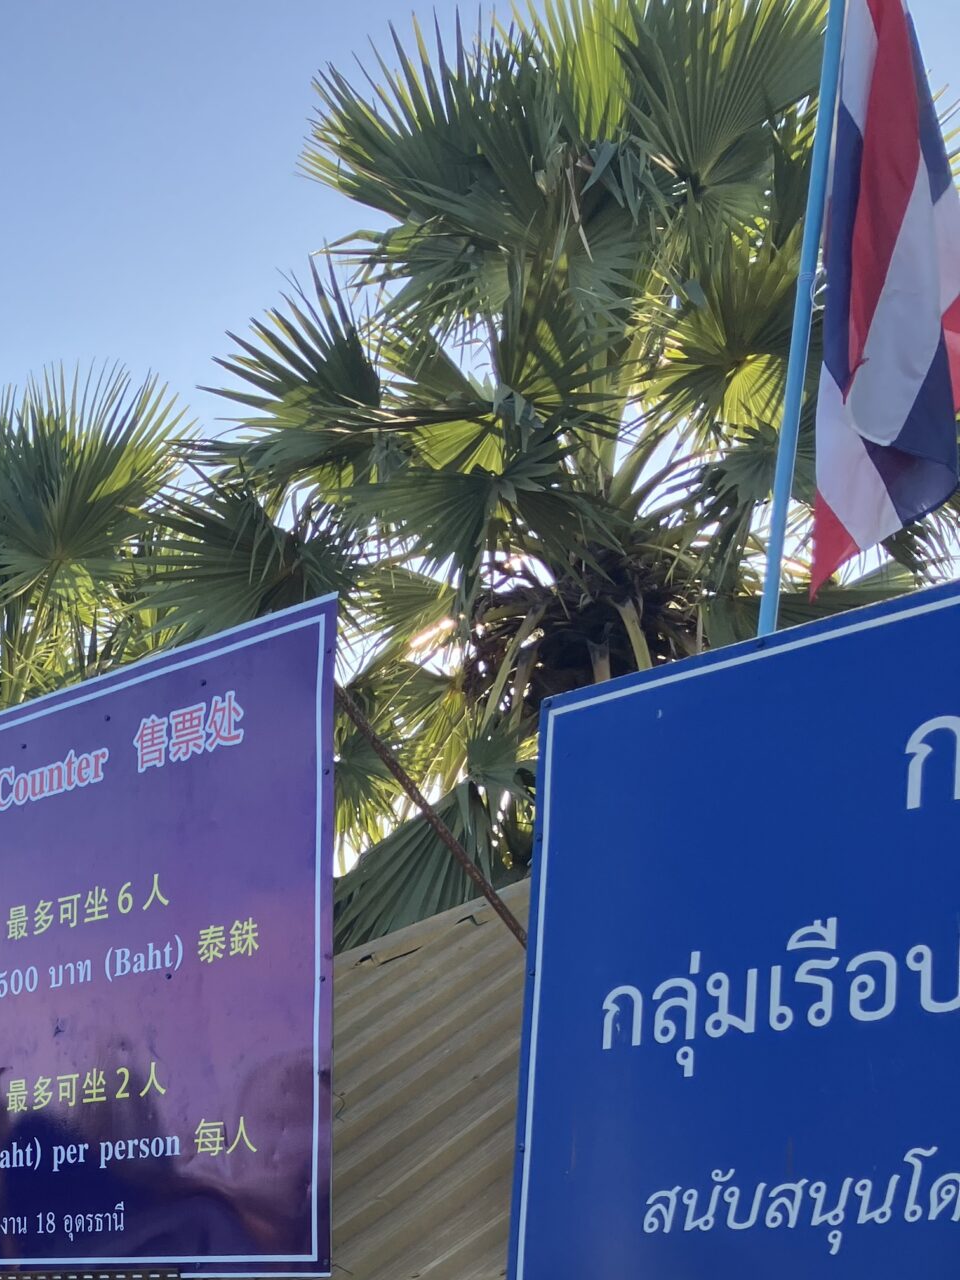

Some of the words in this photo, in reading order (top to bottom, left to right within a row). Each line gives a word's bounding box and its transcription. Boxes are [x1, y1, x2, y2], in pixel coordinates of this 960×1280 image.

[133, 690, 244, 773] 售票处
[117, 881, 133, 914] 6
[48, 959, 92, 989] บาท
[105, 934, 183, 983] (Baht)
[197, 917, 259, 964] 泰銖
[115, 1067, 130, 1099] 2
[52, 1143, 89, 1172] per
[99, 1134, 181, 1169] person
[194, 1116, 257, 1156] 每人
[36, 1212, 56, 1234] 18
[63, 1201, 124, 1242] อุดรธานี
